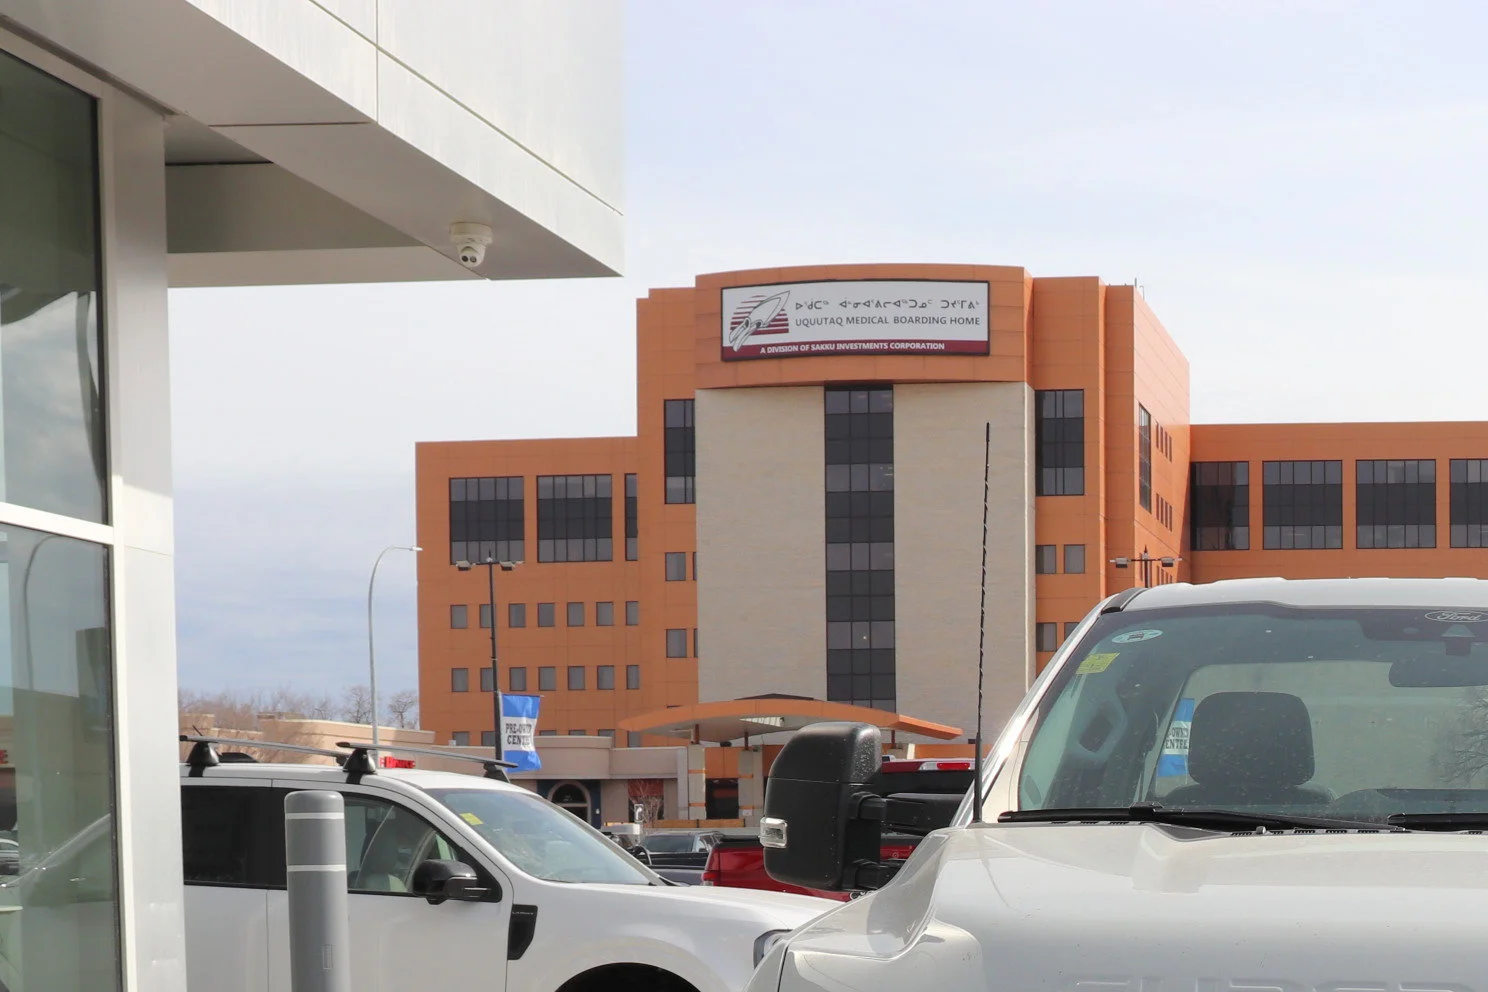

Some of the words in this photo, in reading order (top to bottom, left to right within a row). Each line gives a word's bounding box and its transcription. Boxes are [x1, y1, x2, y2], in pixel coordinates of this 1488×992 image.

[796, 316, 843, 328] UQUUTAQ
[846, 316, 889, 325] MEDICAL
[893, 316, 947, 325] BOARDING
[950, 317, 980, 325] HOME
[767, 344, 799, 353] DIVISION
[836, 342, 888, 350] INVESTMENTS
[889, 342, 945, 350] CORPORATION
